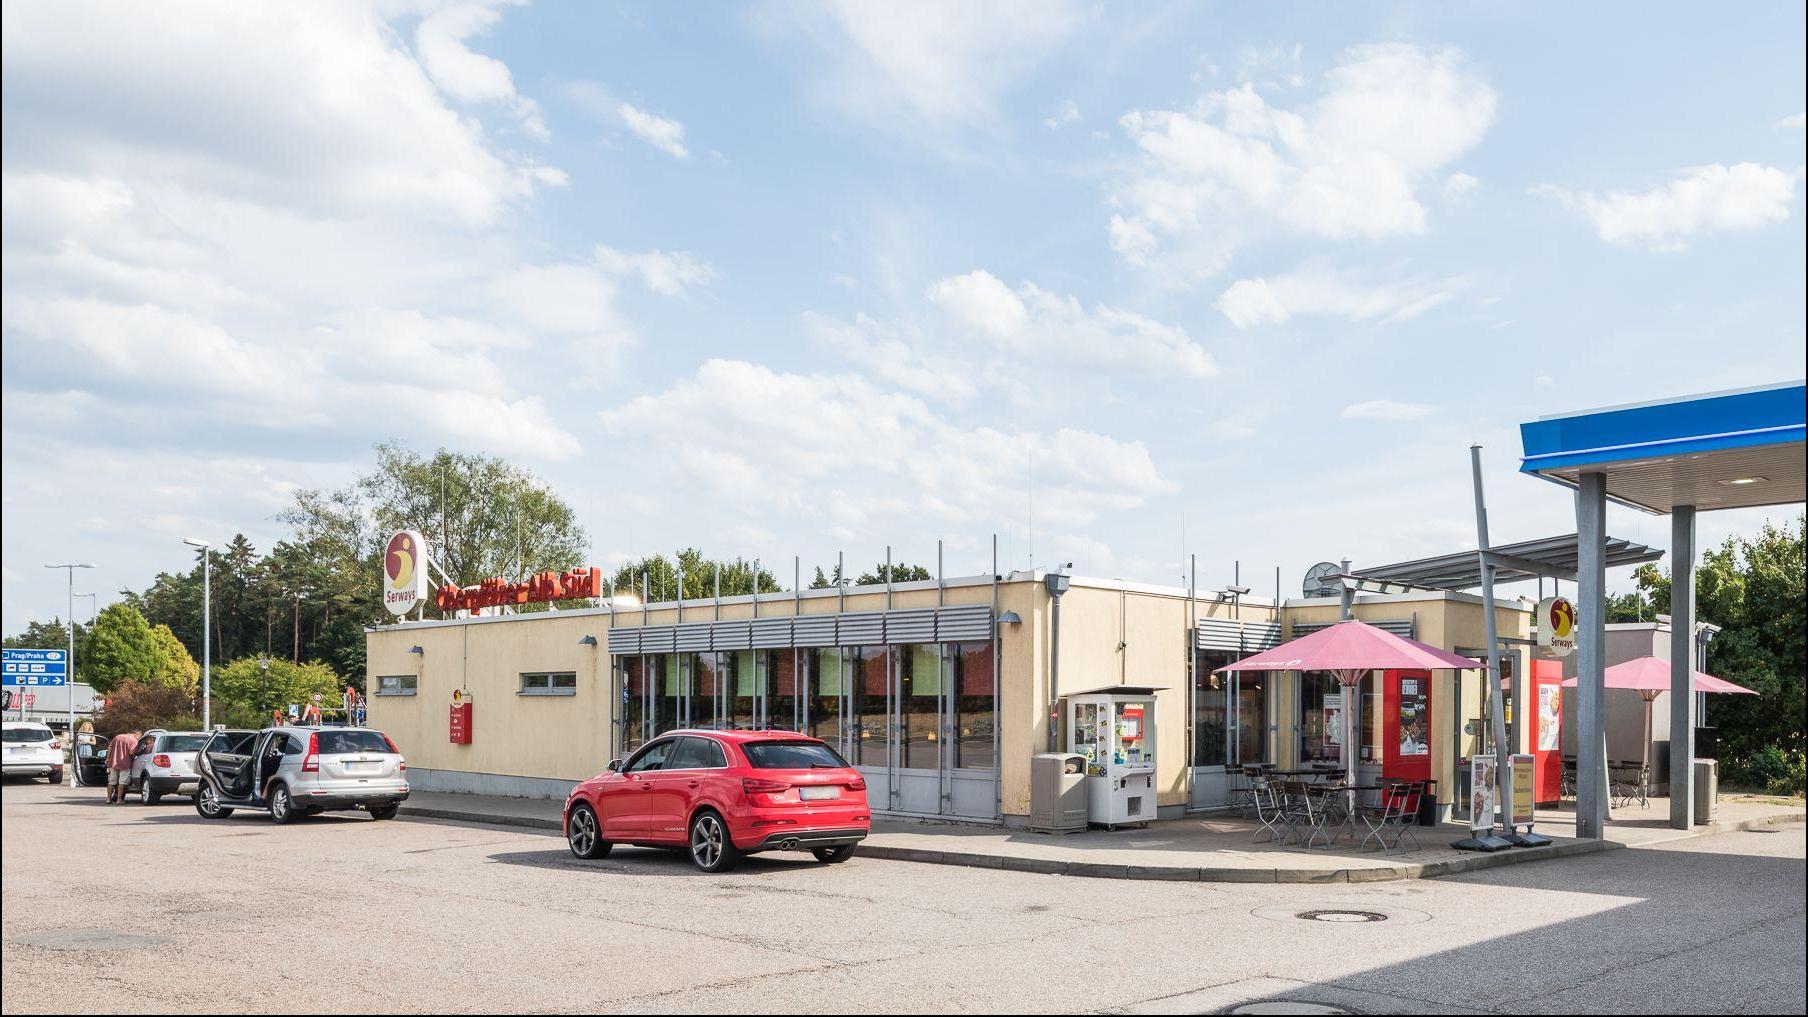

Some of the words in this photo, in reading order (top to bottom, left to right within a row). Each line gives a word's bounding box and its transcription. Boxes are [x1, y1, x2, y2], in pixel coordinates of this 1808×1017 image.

[528, 572, 562, 603] Alb
[559, 567, 601, 599] Süd
[386, 590, 416, 605] Serways
[1551, 636, 1573, 651] Serways
[11, 652, 45, 660] Prag/Praha
